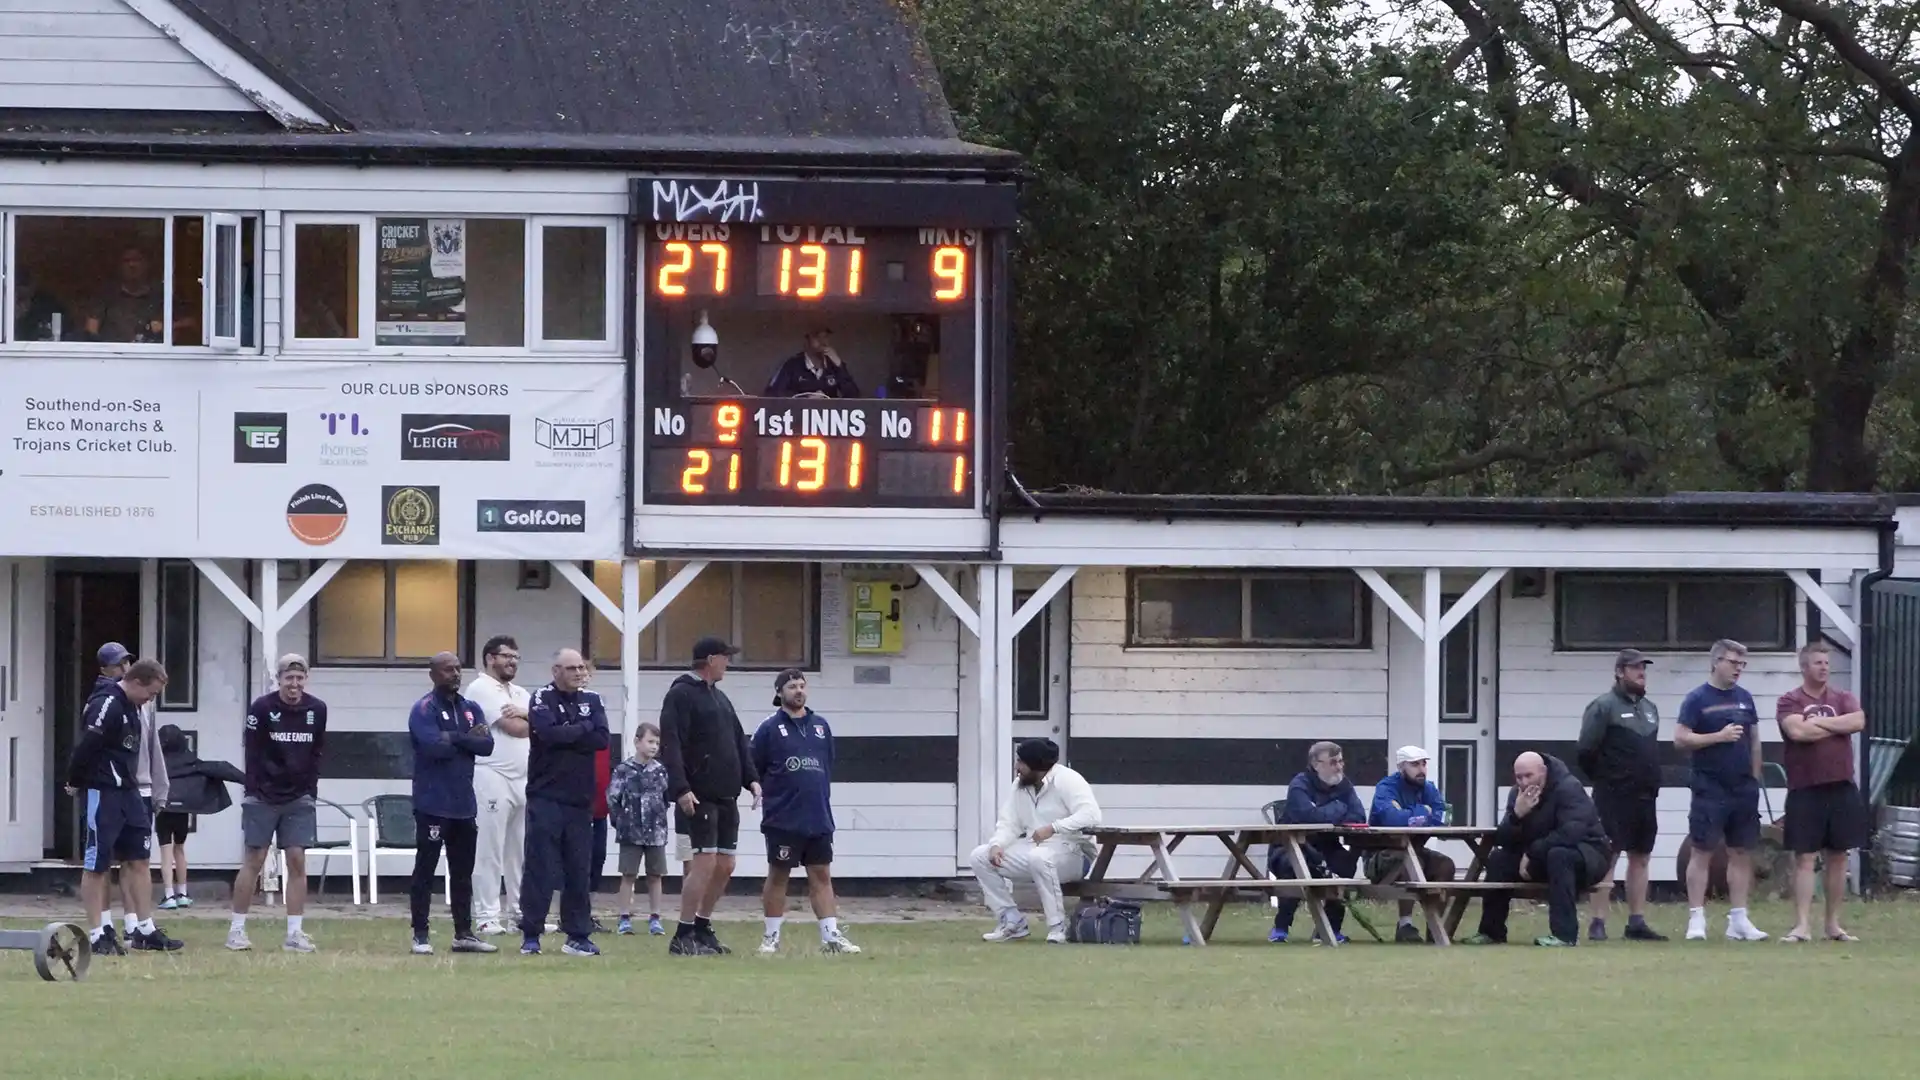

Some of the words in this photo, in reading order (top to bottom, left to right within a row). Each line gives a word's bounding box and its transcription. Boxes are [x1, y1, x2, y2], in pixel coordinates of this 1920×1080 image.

[382, 225, 420, 239] CRICKET
[656, 223, 730, 241] OVERS
[382, 239, 397, 249] FOR
[659, 243, 727, 294] 27
[780, 245, 860, 296] 131
[934, 248, 964, 298] 9
[341, 382, 374, 395] OUR
[379, 383, 420, 395] CLUB
[425, 384, 509, 396] SPONSORS
[25, 397, 161, 412] Southend-on-Sea
[27, 418, 65, 431] Ekco
[71, 419, 148, 432] Monarchs
[153, 420, 164, 432] &
[654, 408, 685, 435] No
[717, 405, 740, 441] 9
[754, 408, 793, 435] 1st
[802, 409, 866, 437] INNS
[881, 410, 912, 438] No
[931, 410, 966, 442] 11
[13, 437, 71, 453] Trojans
[76, 438, 131, 452] Cricket
[137, 440, 177, 452] Club.
[239, 426, 282, 448] TEG
[412, 437, 457, 448] LEIGH
[553, 428, 596, 446] MJH
[683, 450, 738, 492] 21
[780, 438, 860, 490] 131
[954, 456, 965, 493] 1
[290, 494, 311, 509] Finish
[326, 495, 345, 509] Fund
[30, 505, 122, 517] ESTABLISHED
[126, 507, 155, 517] 1876
[485, 510, 492, 522] 1
[504, 510, 582, 525] Golf.One
[385, 523, 436, 536] EXCHANGE
[269, 732, 292, 742] WHOLE
[292, 733, 313, 742] EARTH
